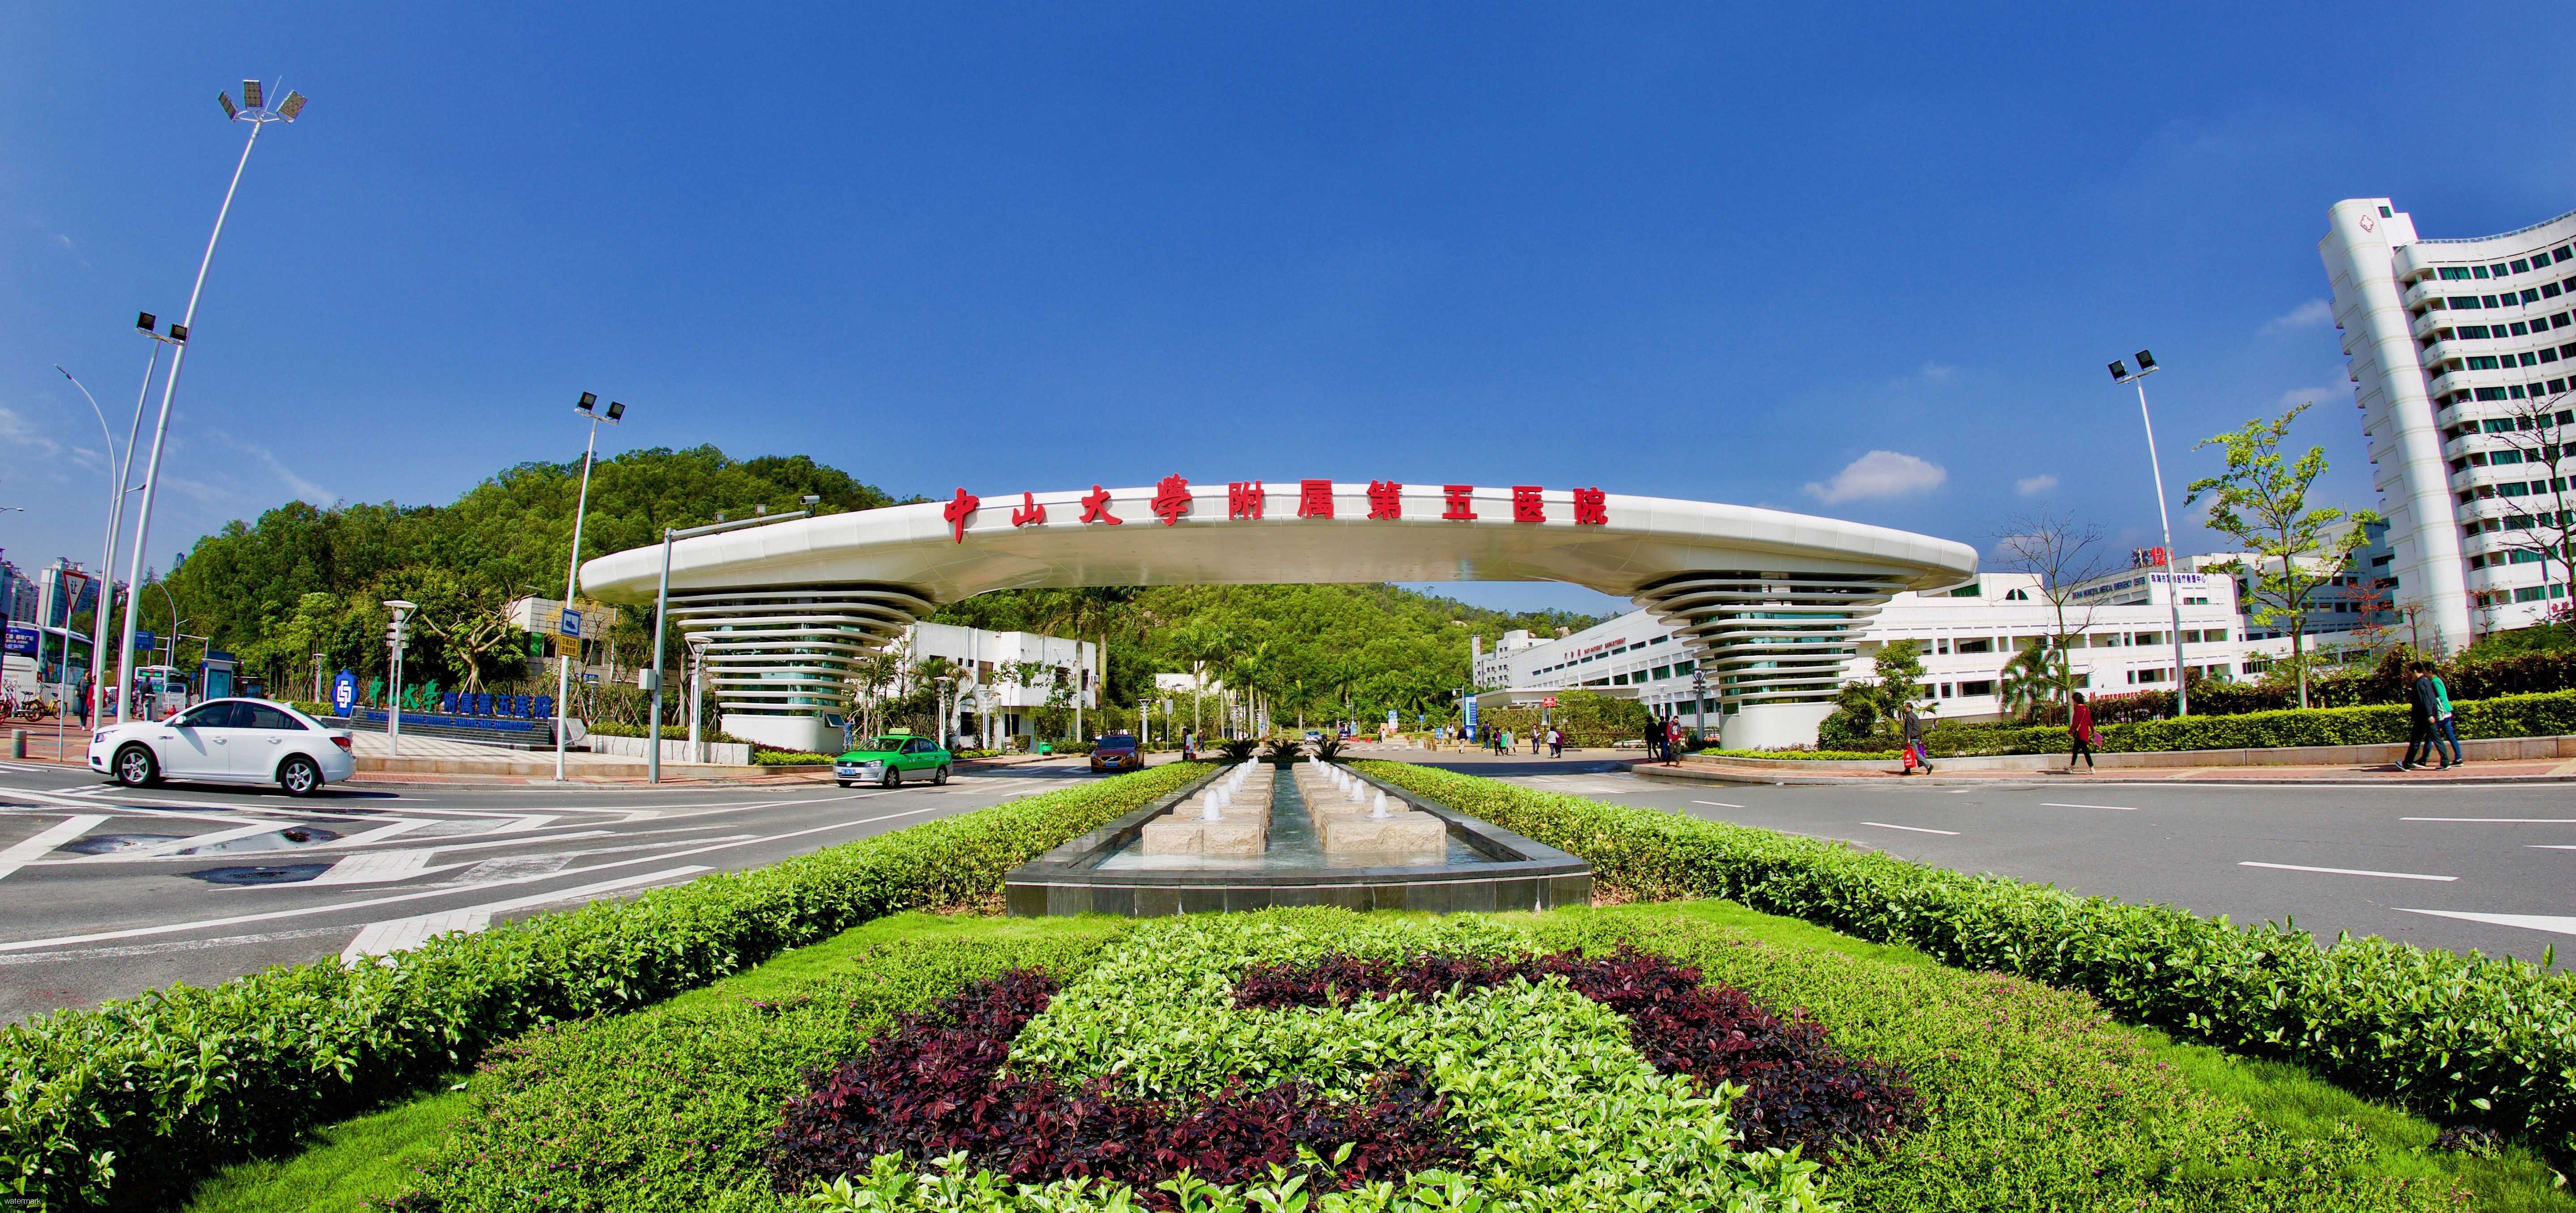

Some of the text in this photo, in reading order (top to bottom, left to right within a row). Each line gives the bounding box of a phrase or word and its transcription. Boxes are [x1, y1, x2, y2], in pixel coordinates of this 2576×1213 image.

[2099, 583, 2113, 594] MEDICAL
[2114, 580, 2132, 590] EMERGENCY
[2133, 577, 2145, 586] CENTER
[2151, 574, 2206, 584] 珠海市医疗救援中心
[70, 580, 77, 594] 让
